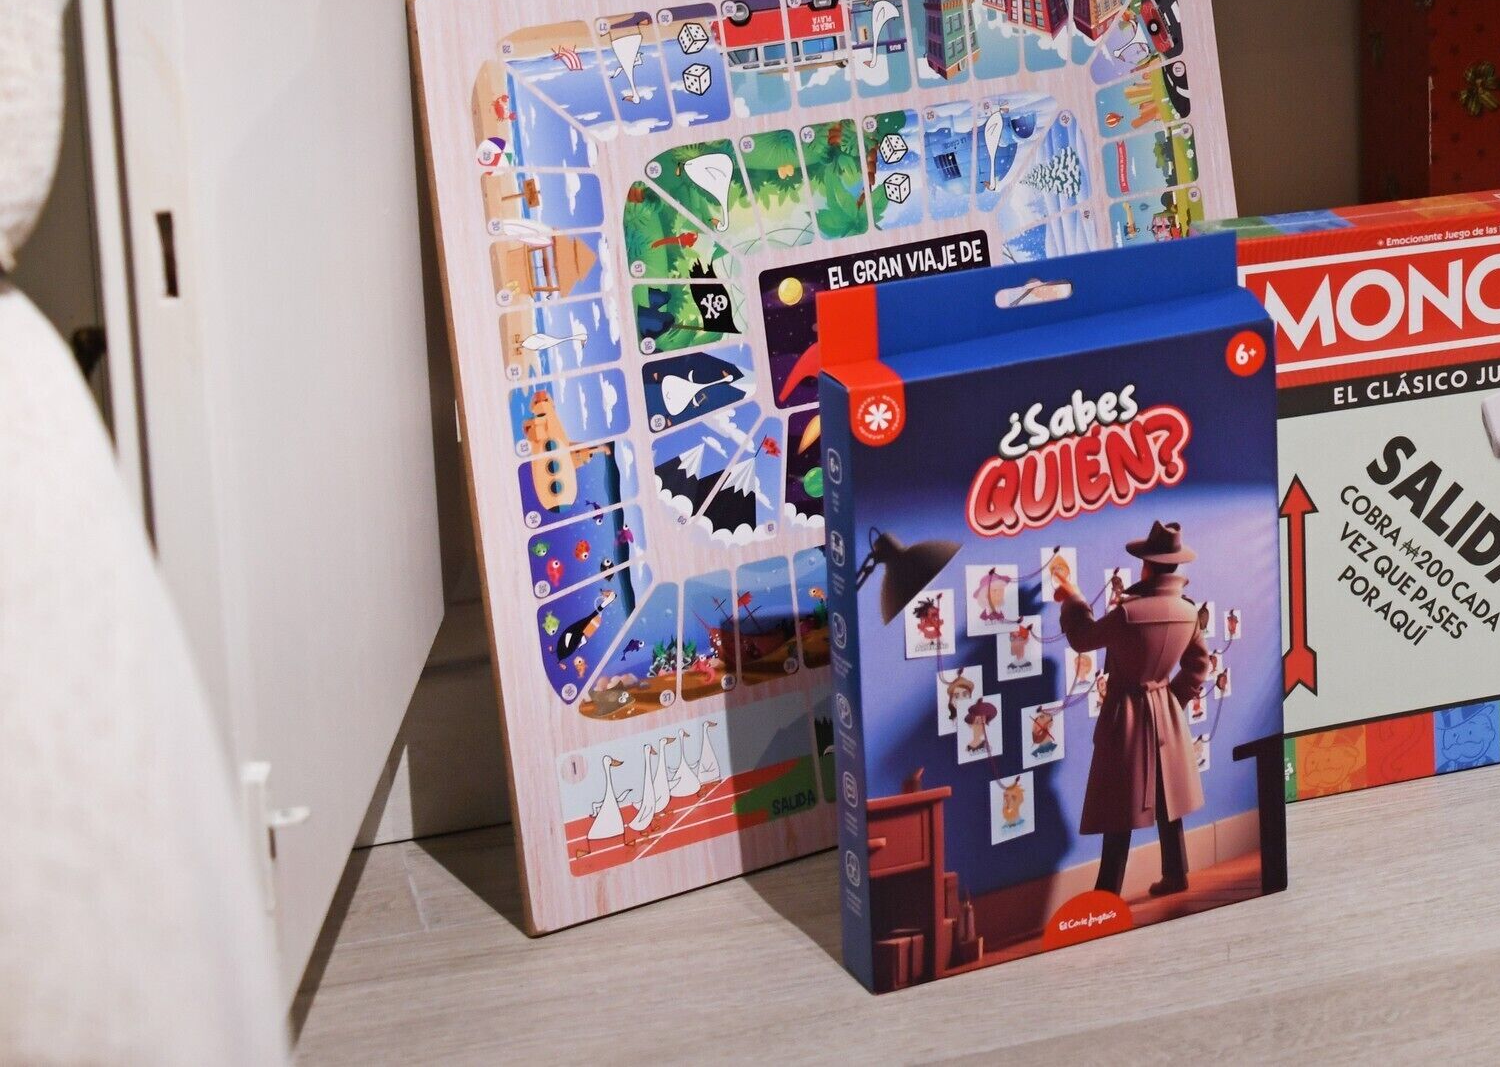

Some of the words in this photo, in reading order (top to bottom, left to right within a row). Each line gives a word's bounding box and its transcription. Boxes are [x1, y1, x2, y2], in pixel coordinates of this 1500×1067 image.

[828, 265, 850, 291] EL
[852, 253, 903, 283] GRAN
[905, 243, 959, 276] VIAJE
[960, 238, 983, 263] DE
[1386, 232, 1443, 247] Emocionante
[1444, 229, 1471, 241] Juego
[1472, 227, 1484, 236] de
[1485, 225, 1498, 235] las
[1234, 344, 1257, 365] 6+
[1333, 386, 1358, 406] EL
[1367, 369, 1468, 402] CLÁSICO
[1000, 384, 1138, 458] ¿Sabes
[966, 404, 1192, 537] QUIÉN?
[1339, 484, 1402, 548] COBRA
[1338, 565, 1374, 608] POR
[1374, 600, 1434, 647] AQUÍ
[1339, 522, 1373, 564] VEZ
[1374, 556, 1414, 598] QUE
[1411, 586, 1468, 640] PASES
[772, 788, 816, 816] SALIDA
